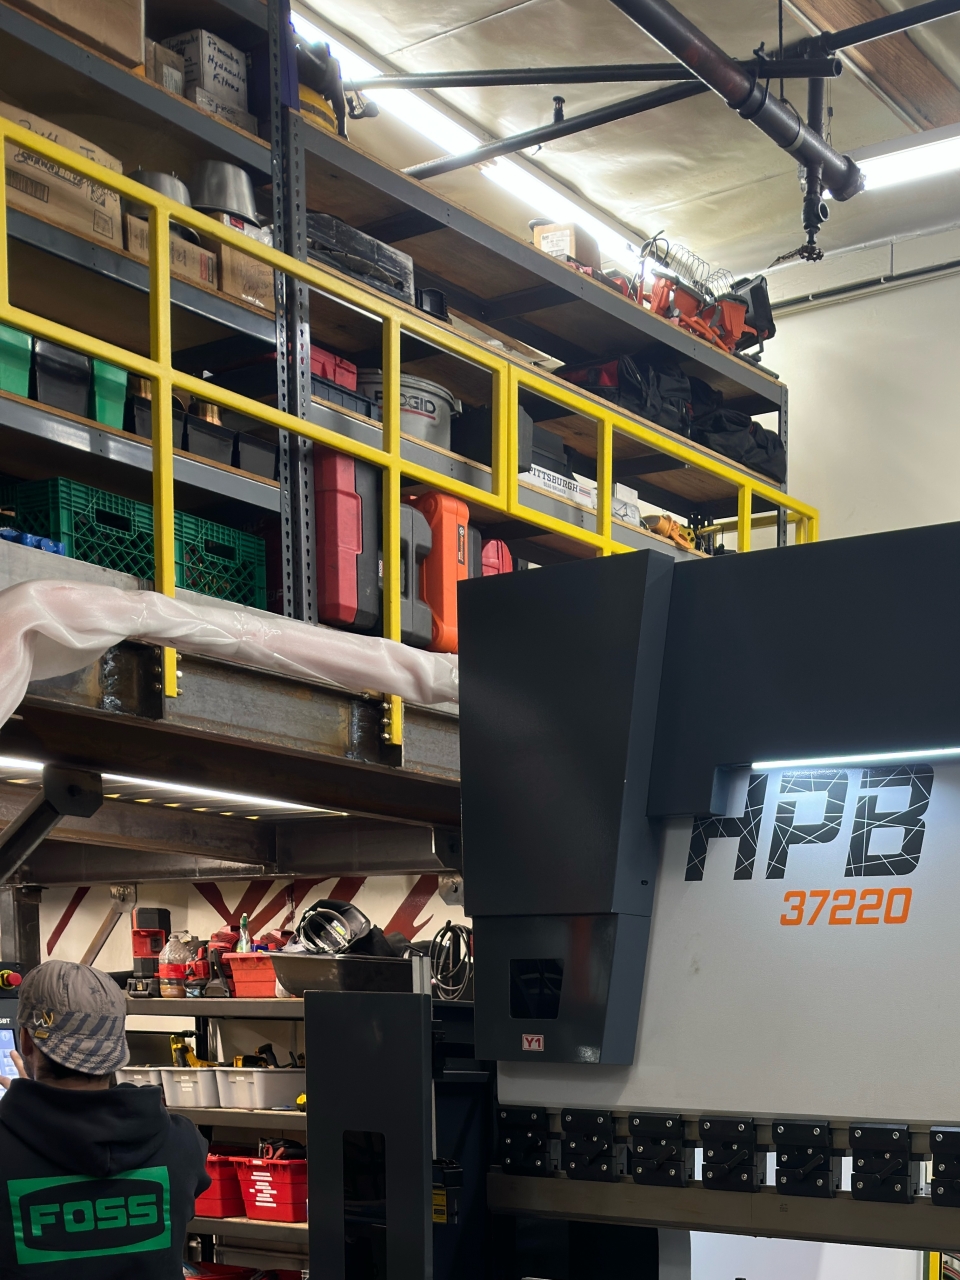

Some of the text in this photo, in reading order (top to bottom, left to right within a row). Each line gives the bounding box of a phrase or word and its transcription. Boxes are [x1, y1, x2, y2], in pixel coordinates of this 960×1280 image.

[375, 390, 437, 414] RDGID
[684, 763, 934, 881] HPB
[780, 887, 912, 926] 37220
[525, 1037, 541, 1048] Y1
[30, 1194, 157, 1236] FOSS
